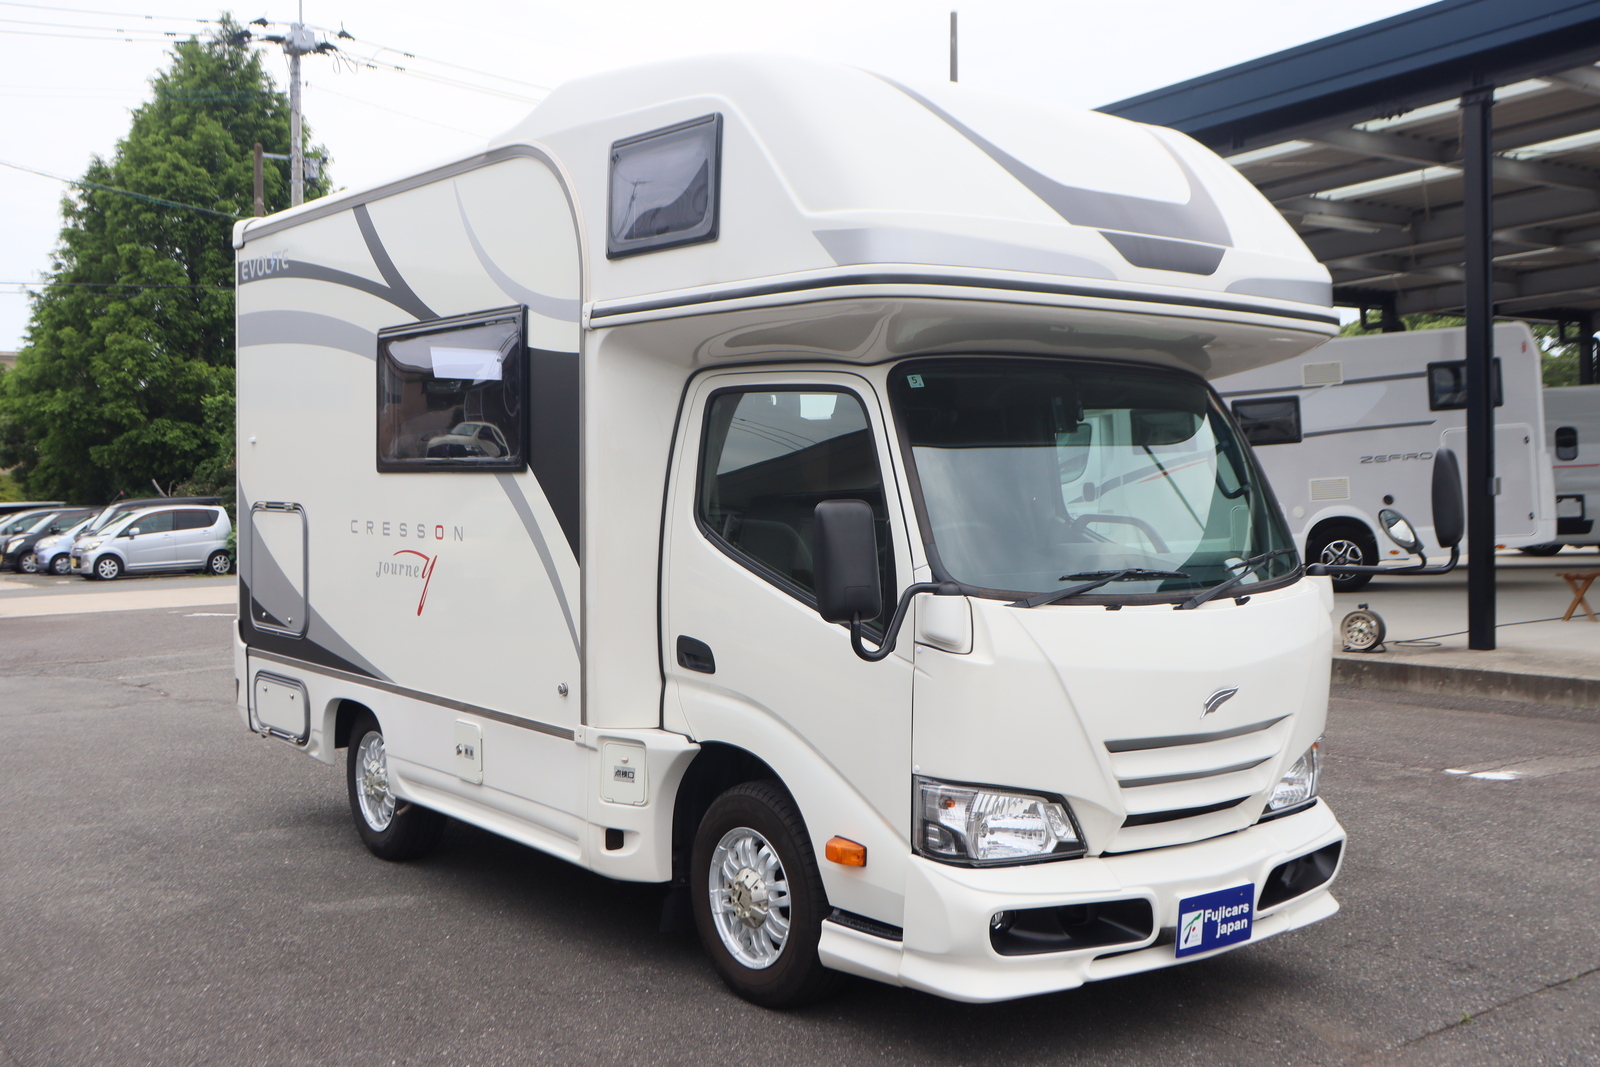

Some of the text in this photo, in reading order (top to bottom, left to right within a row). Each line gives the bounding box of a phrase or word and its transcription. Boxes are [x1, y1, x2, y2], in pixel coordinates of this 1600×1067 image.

[1359, 451, 1434, 464] ZEFIRO
[350, 519, 464, 542] CRESSON
[1204, 903, 1250, 923] Fujicars
